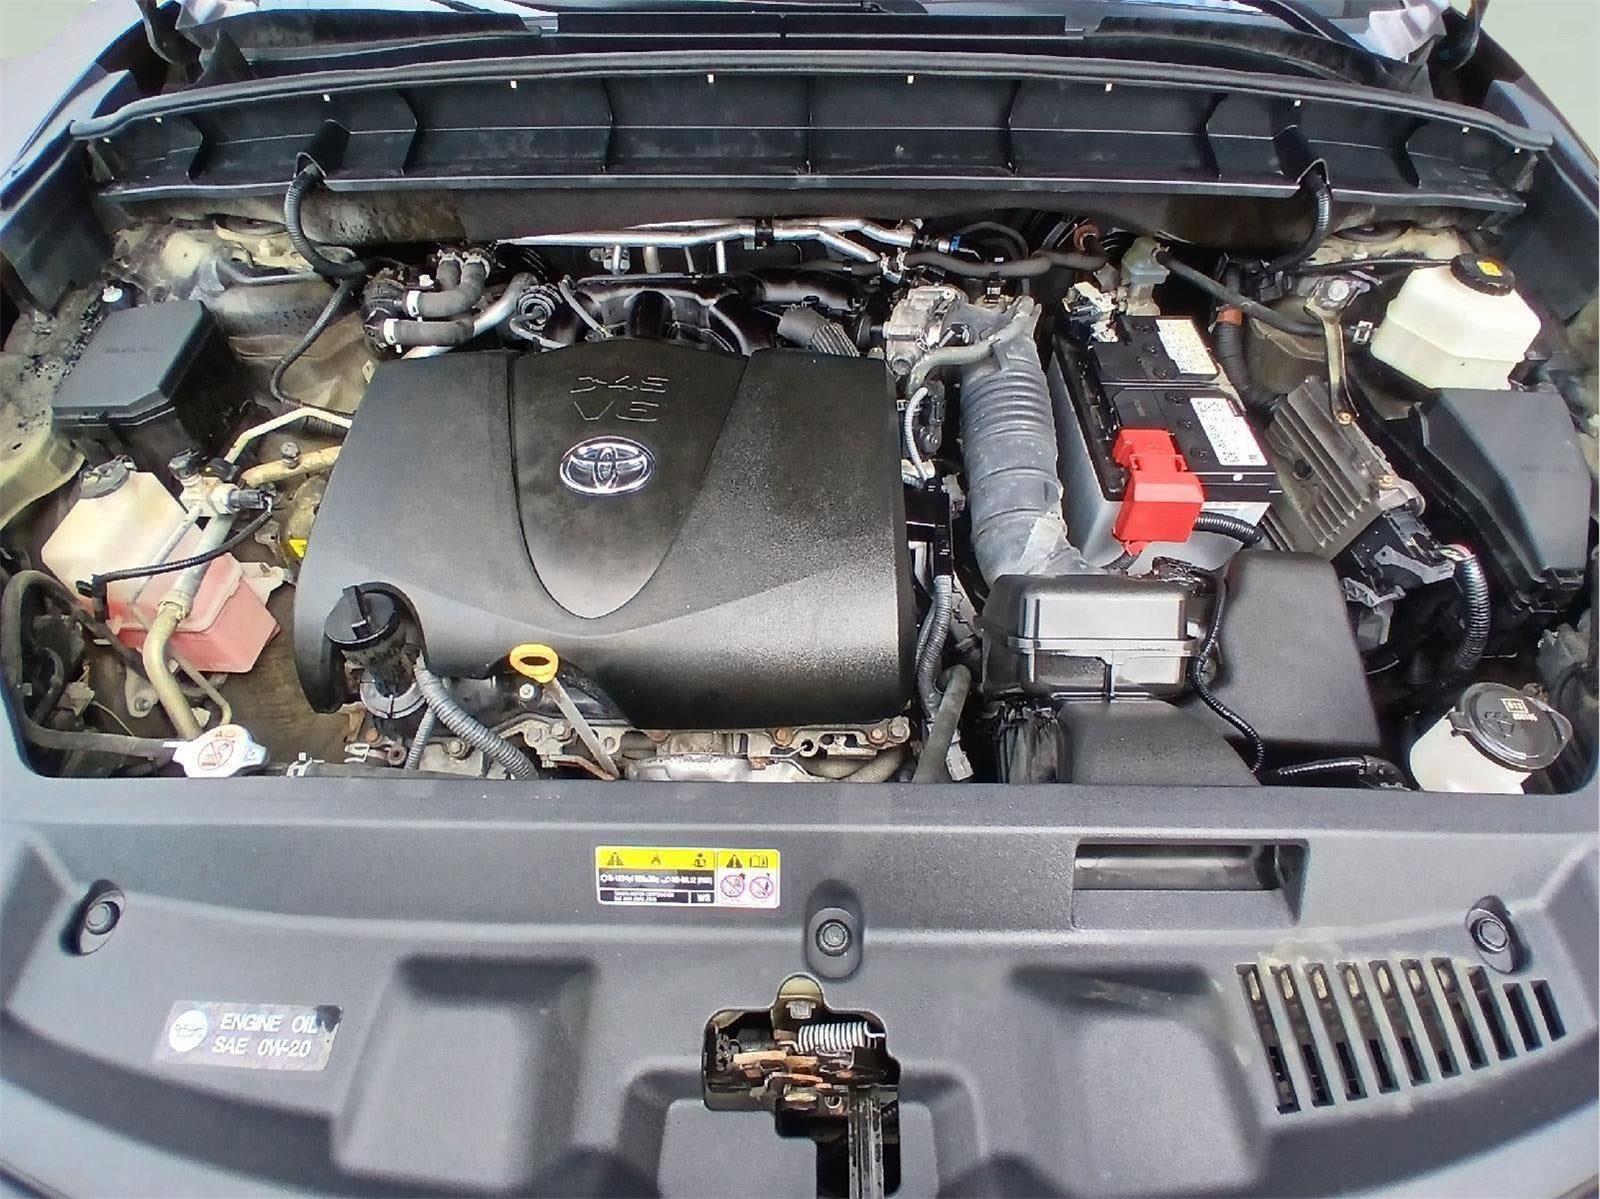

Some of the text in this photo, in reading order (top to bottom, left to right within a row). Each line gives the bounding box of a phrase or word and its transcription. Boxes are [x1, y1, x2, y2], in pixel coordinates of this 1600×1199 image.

[219, 1012, 318, 1034] ENGINE OIL
[212, 1035, 312, 1058] SAE 0W-20
